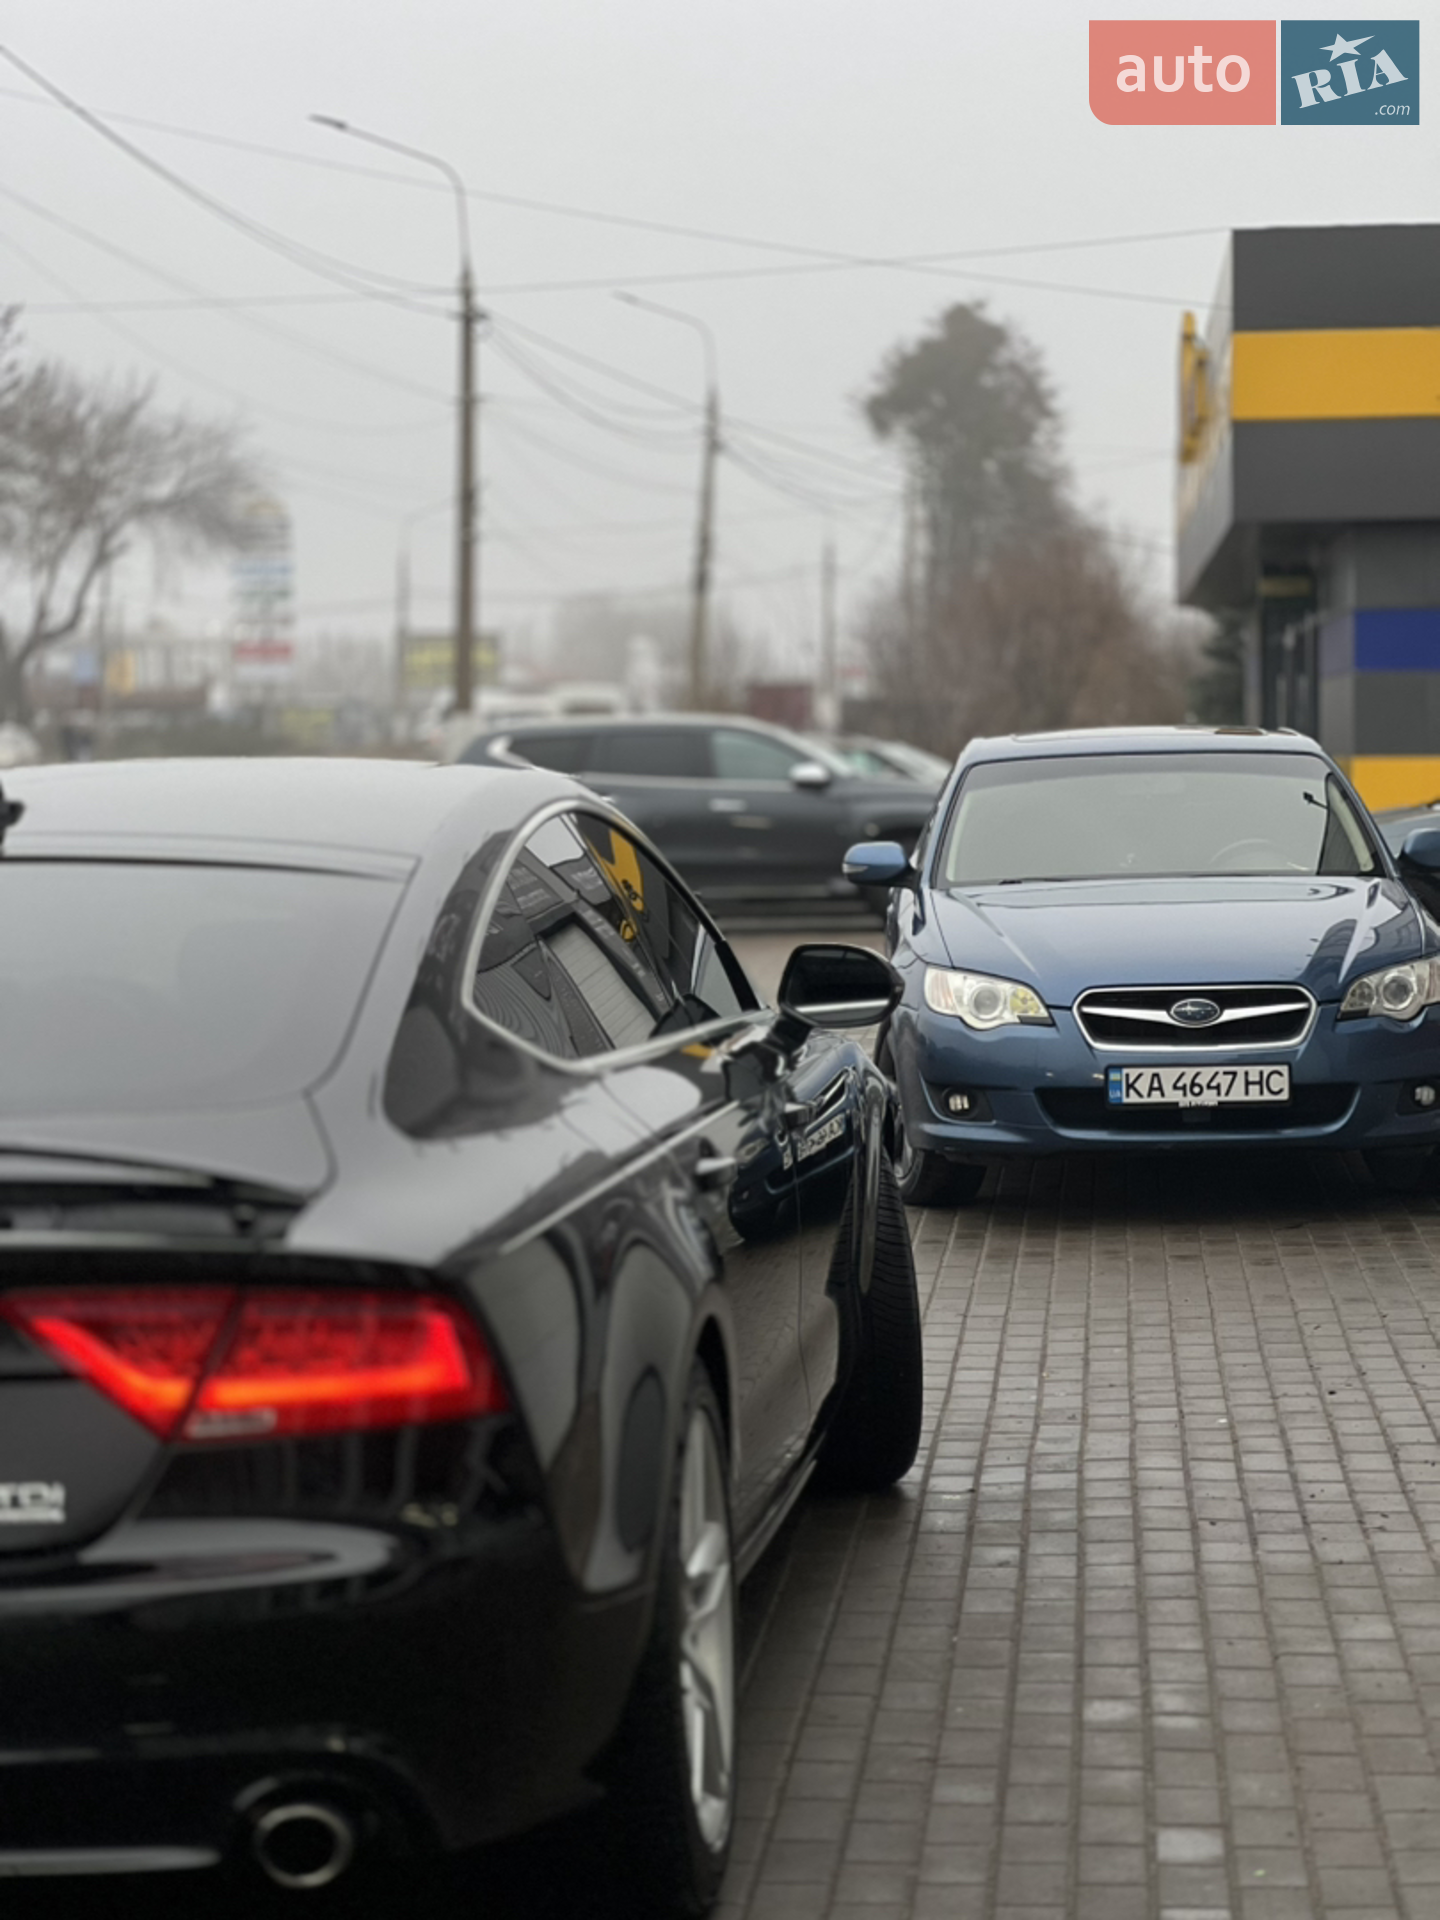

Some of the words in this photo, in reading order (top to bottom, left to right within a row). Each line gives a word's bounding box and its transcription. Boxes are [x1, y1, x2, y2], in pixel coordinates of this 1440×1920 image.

[1125, 1072, 1165, 1098] KA
[1172, 1070, 1238, 1097] 4647
[1244, 1069, 1284, 1096] HC
